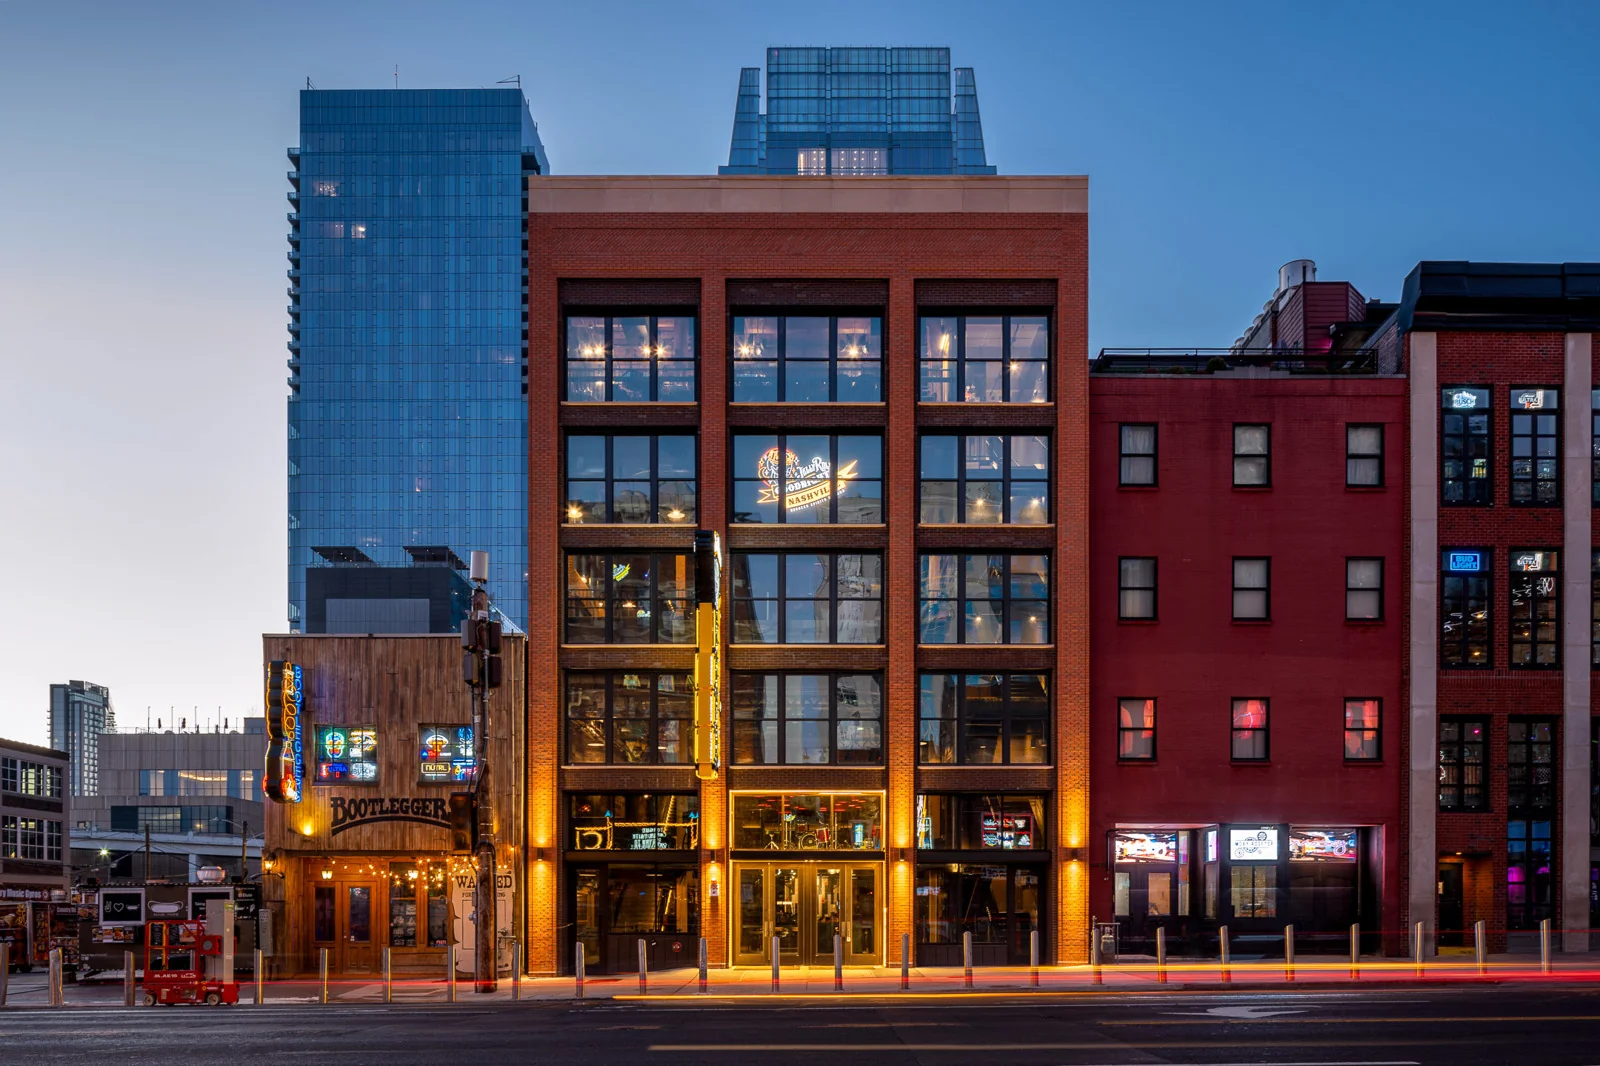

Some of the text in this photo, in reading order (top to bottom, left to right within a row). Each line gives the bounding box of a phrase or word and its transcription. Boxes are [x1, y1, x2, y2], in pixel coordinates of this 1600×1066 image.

[455, 875, 512, 888] WAED
[7, 889, 25, 898] Music
[25, 889, 41, 899] Gyros
